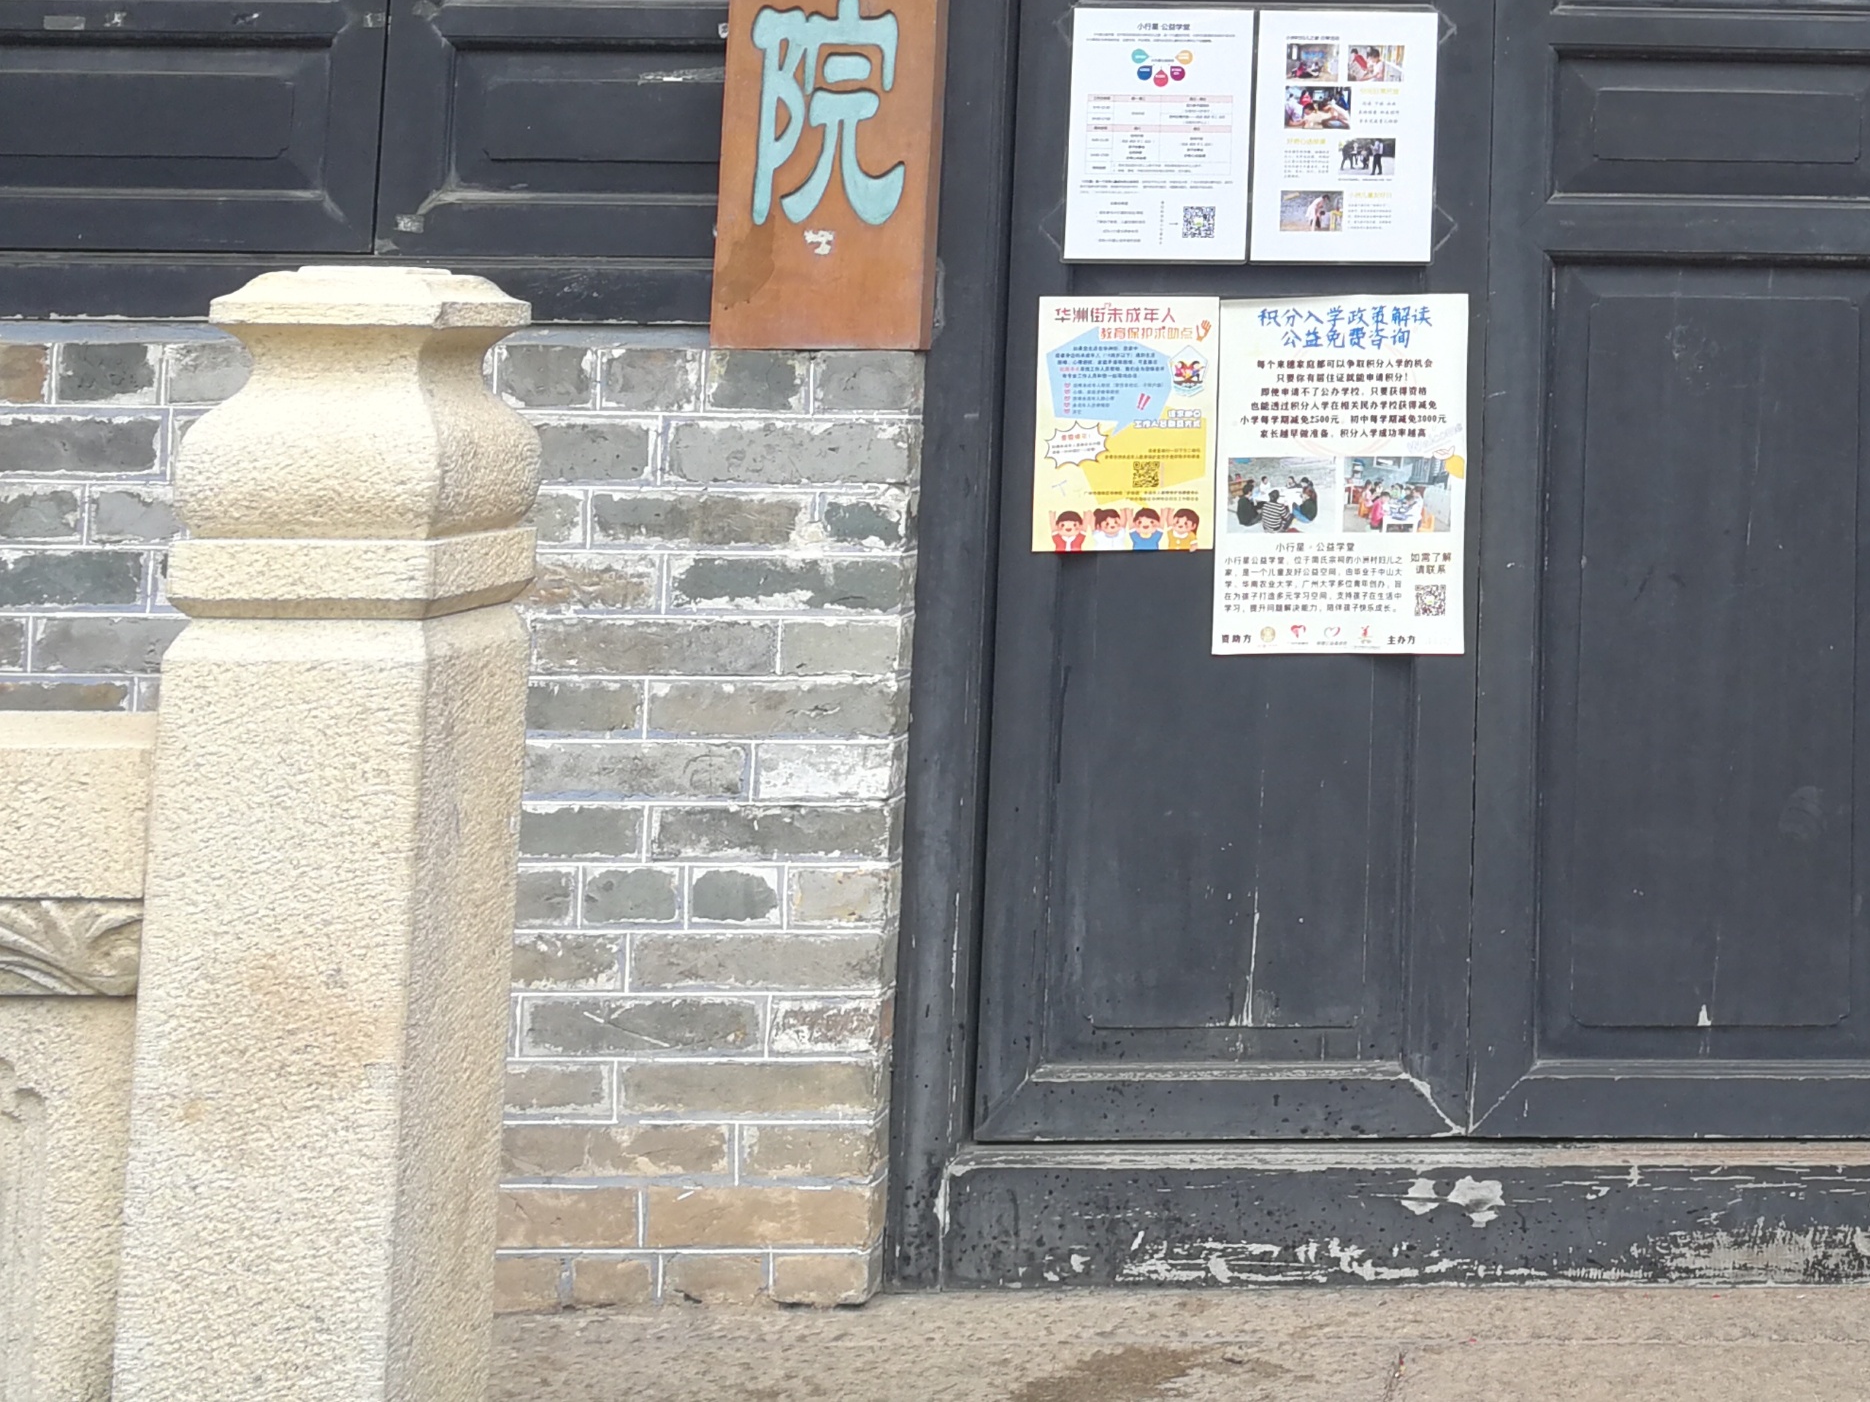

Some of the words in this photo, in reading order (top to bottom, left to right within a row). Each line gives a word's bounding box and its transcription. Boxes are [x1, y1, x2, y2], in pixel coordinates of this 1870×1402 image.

[1055, 306, 1176, 323] 华洲街未成年人
[1257, 304, 1433, 328] 积分入学政策解读
[1100, 326, 1193, 340] 教育保护求助点
[1280, 327, 1411, 350] 公益免费咨询
[1410, 552, 1452, 563] 如需了解
[1415, 564, 1447, 574] 请联系
[1387, 634, 1416, 645] 主办方
